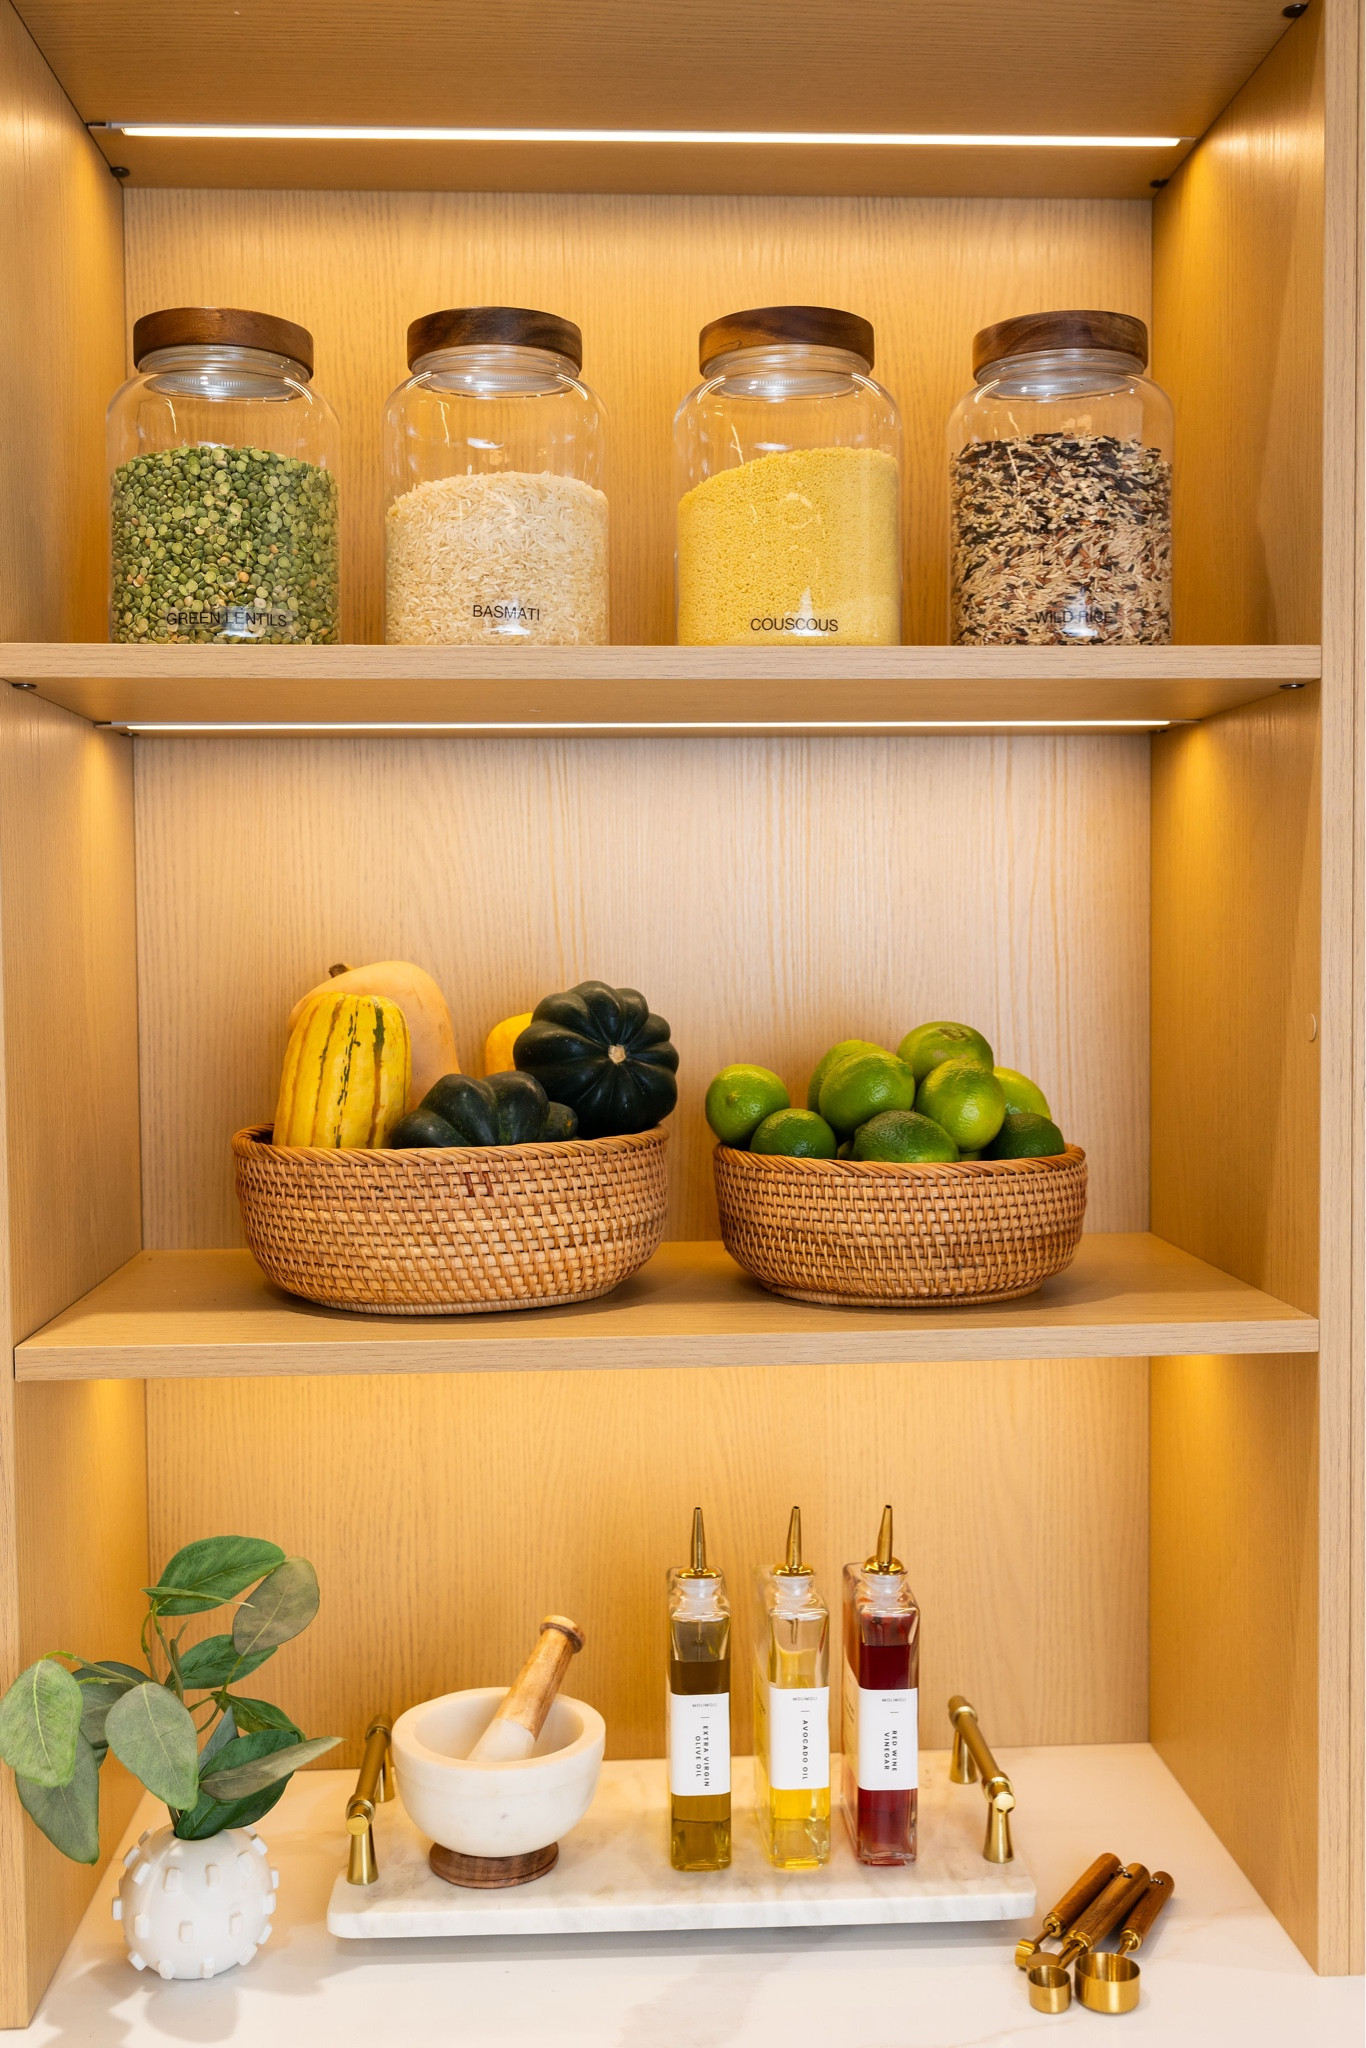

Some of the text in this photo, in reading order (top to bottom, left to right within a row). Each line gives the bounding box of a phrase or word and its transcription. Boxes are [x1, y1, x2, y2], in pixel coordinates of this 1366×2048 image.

[167, 612, 287, 627] GREEN LENTILS
[473, 605, 540, 621] BASMATI
[1035, 610, 1112, 624] WILD RICE
[751, 618, 838, 632] COUSCOUS
